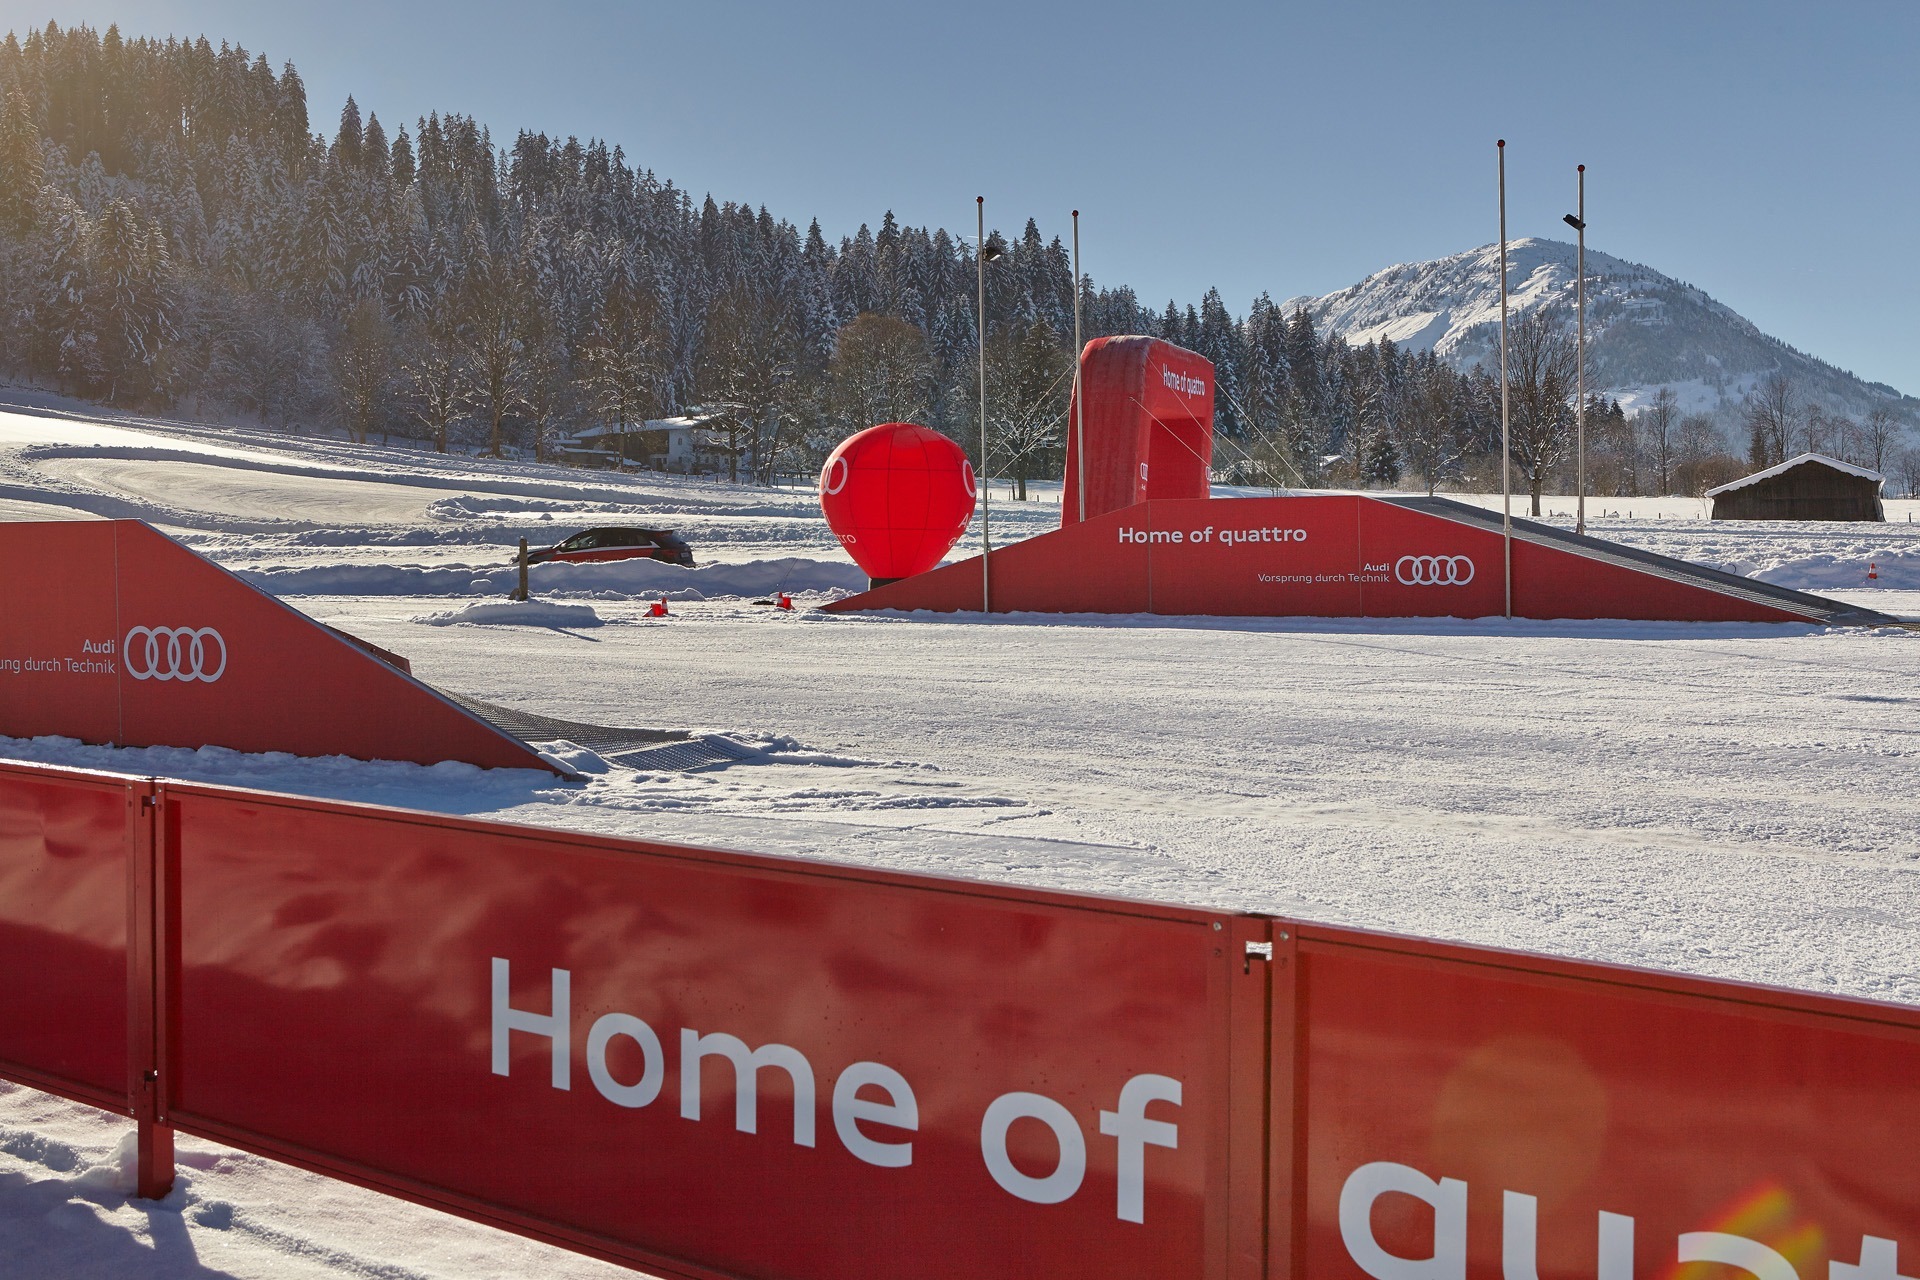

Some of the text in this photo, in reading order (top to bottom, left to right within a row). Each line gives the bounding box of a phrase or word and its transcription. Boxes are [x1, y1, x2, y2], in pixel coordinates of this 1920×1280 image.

[1163, 363, 1179, 391] Home
[1181, 370, 1186, 392] of
[1118, 526, 1307, 546] Home of quattro
[1363, 562, 1390, 572] Audi
[1258, 573, 1390, 583] Vorsprung durch Technik
[82, 639, 115, 653] Audi
[24, 656, 61, 672] durch
[64, 657, 115, 673] Technik
[492, 957, 919, 1167] Home
[981, 1073, 1182, 1224] of
